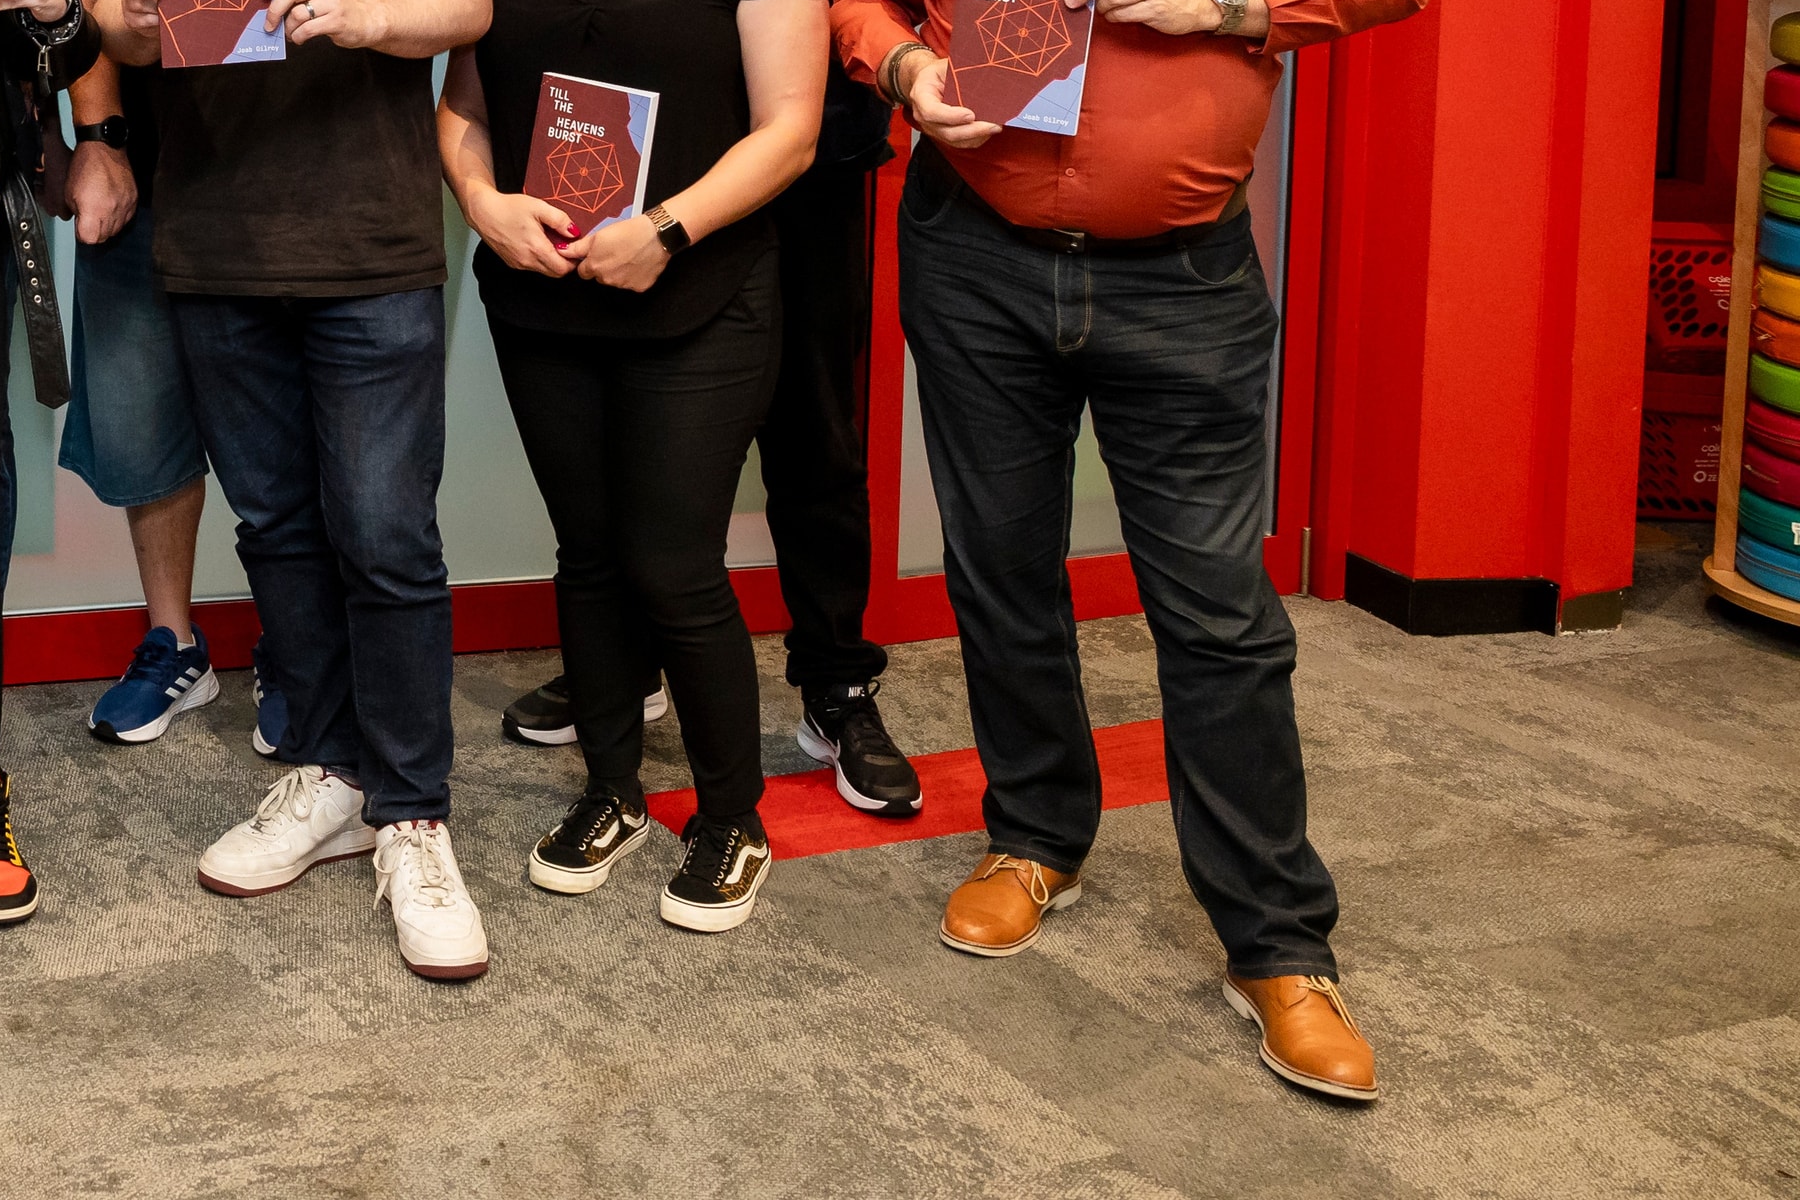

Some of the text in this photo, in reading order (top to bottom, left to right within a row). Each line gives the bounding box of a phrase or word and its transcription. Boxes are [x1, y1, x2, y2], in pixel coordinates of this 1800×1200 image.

[255, 45, 280, 53] Gilroy
[549, 86, 570, 101] TILL
[554, 100, 574, 114] THE
[556, 116, 605, 138] HEAVENS
[1043, 115, 1069, 127] Gilroy
[547, 126, 582, 144] BURST
